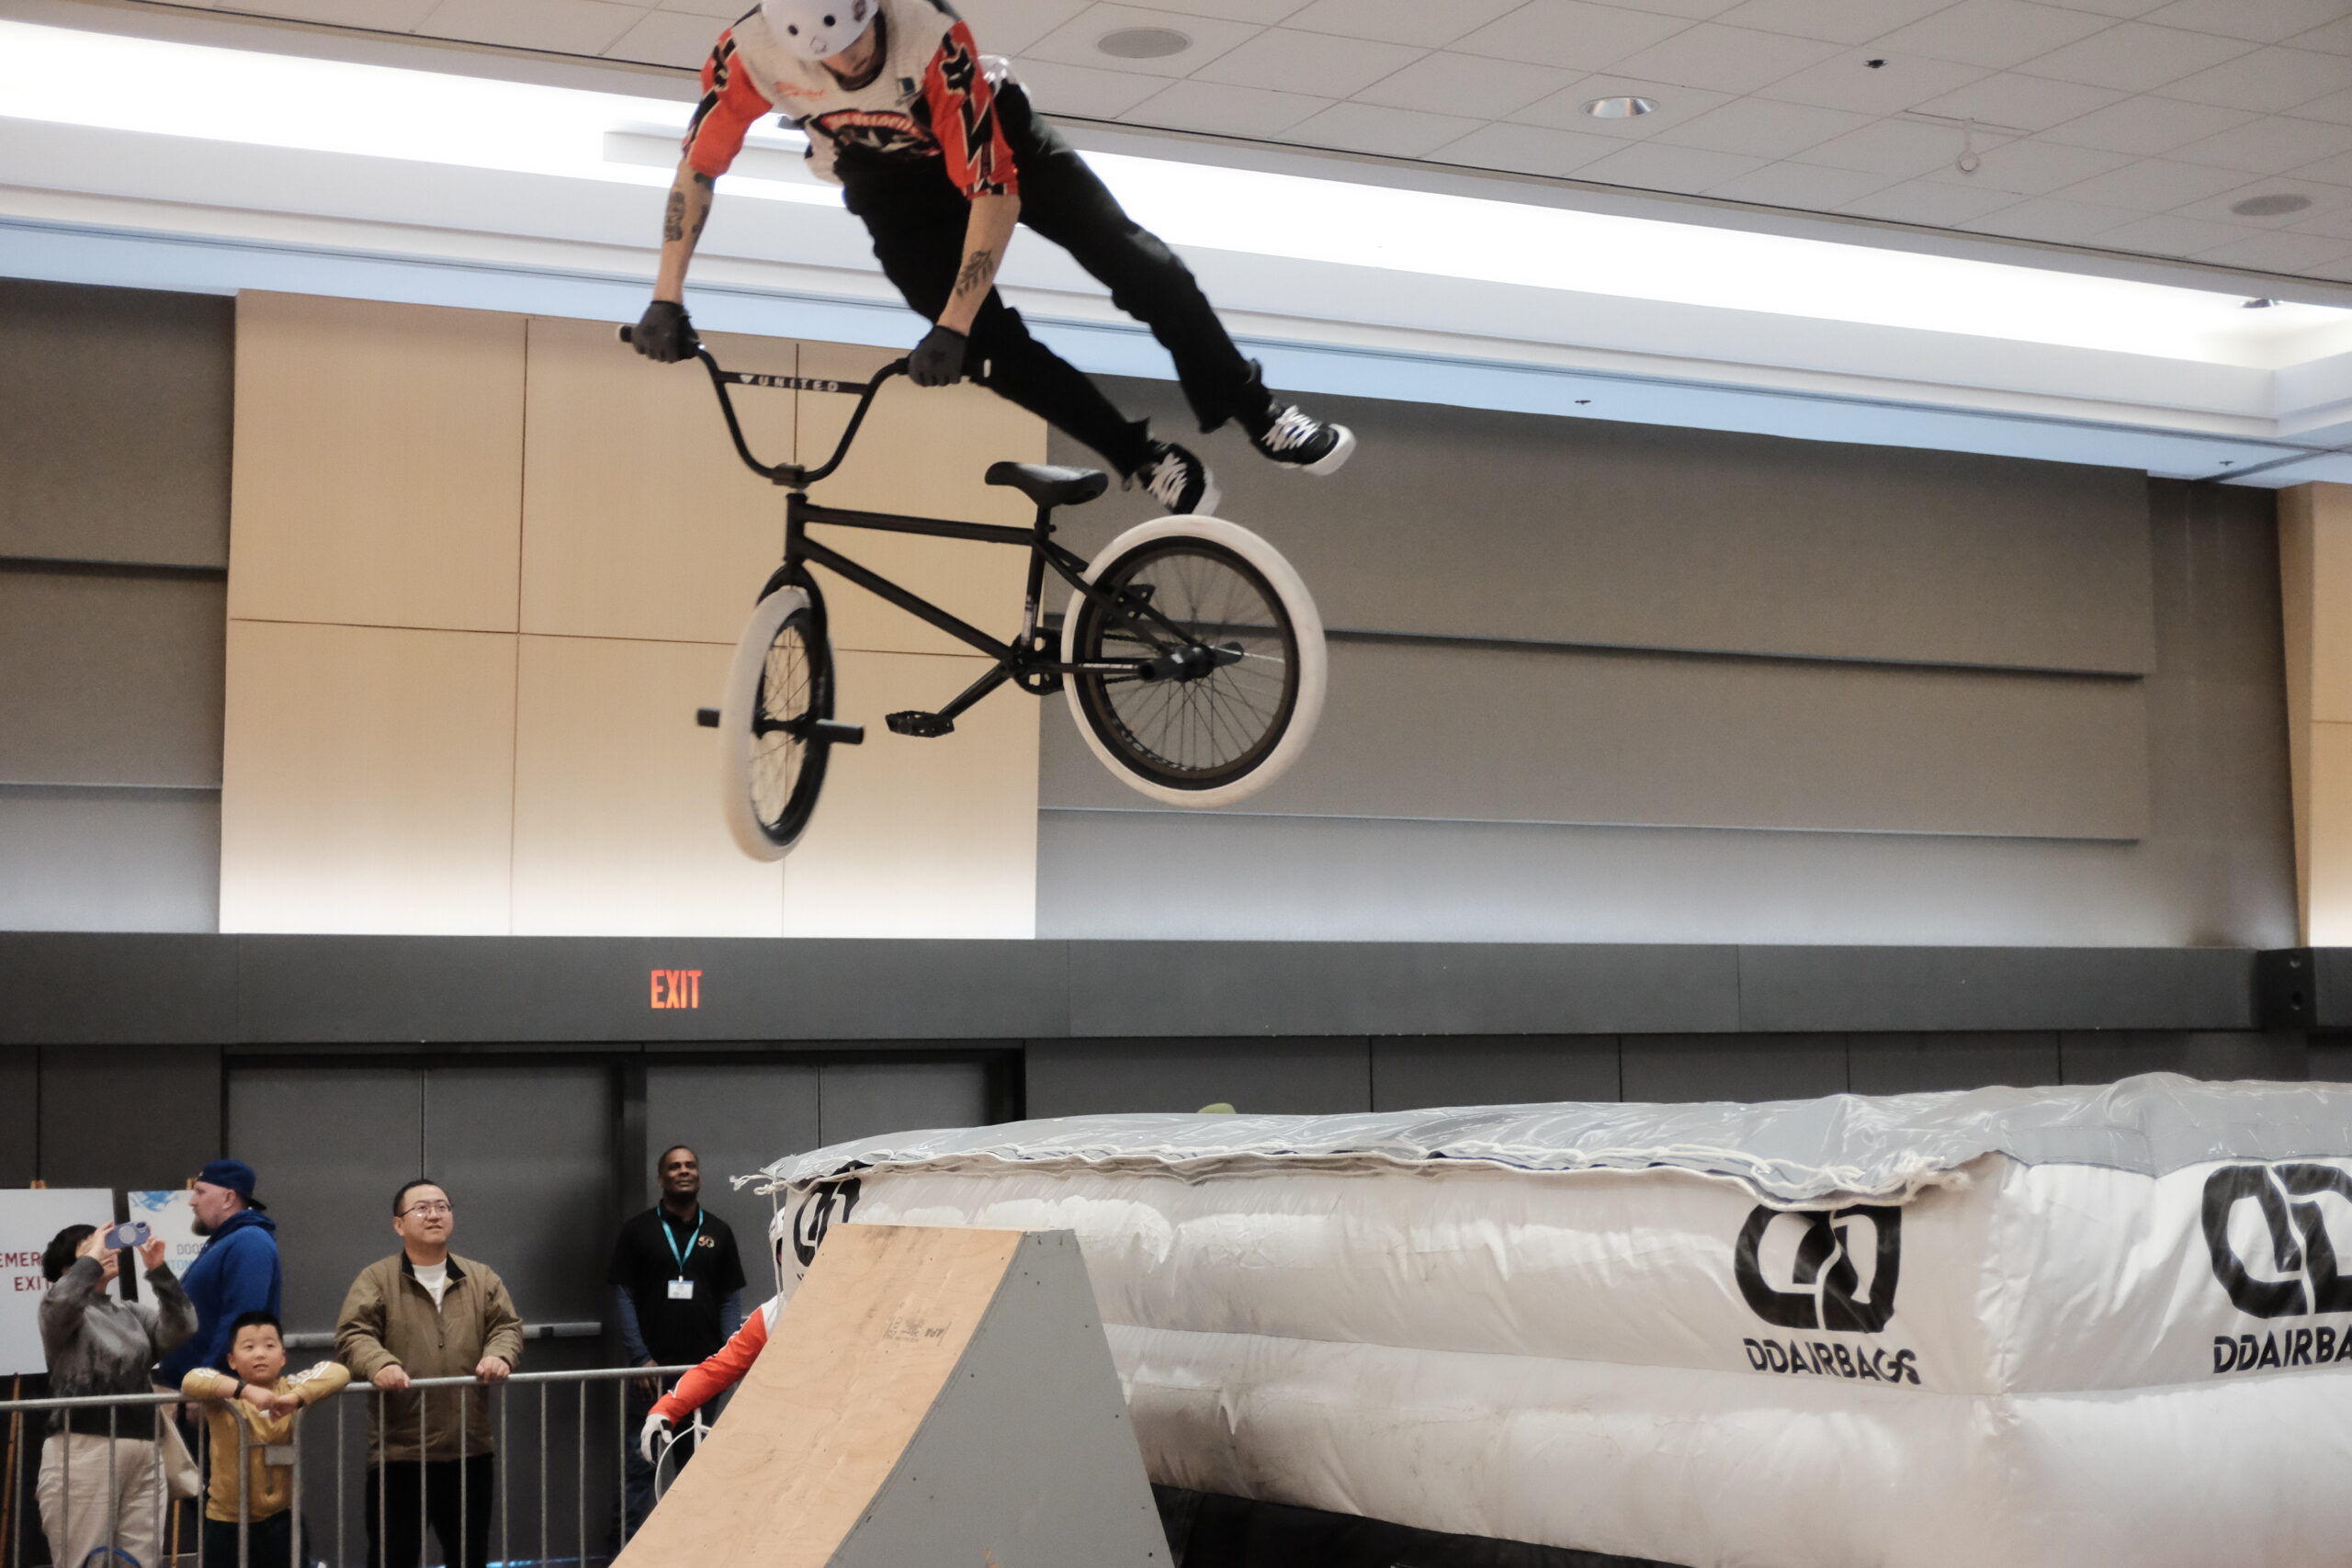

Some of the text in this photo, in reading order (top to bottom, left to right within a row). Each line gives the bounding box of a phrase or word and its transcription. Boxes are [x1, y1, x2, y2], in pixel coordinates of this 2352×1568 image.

[758, 375, 839, 392] UNITED
[650, 969, 703, 1009] EXIT
[0, 1251, 44, 1268] EMER
[1743, 1337, 1921, 1385] DDAIRBAGS
